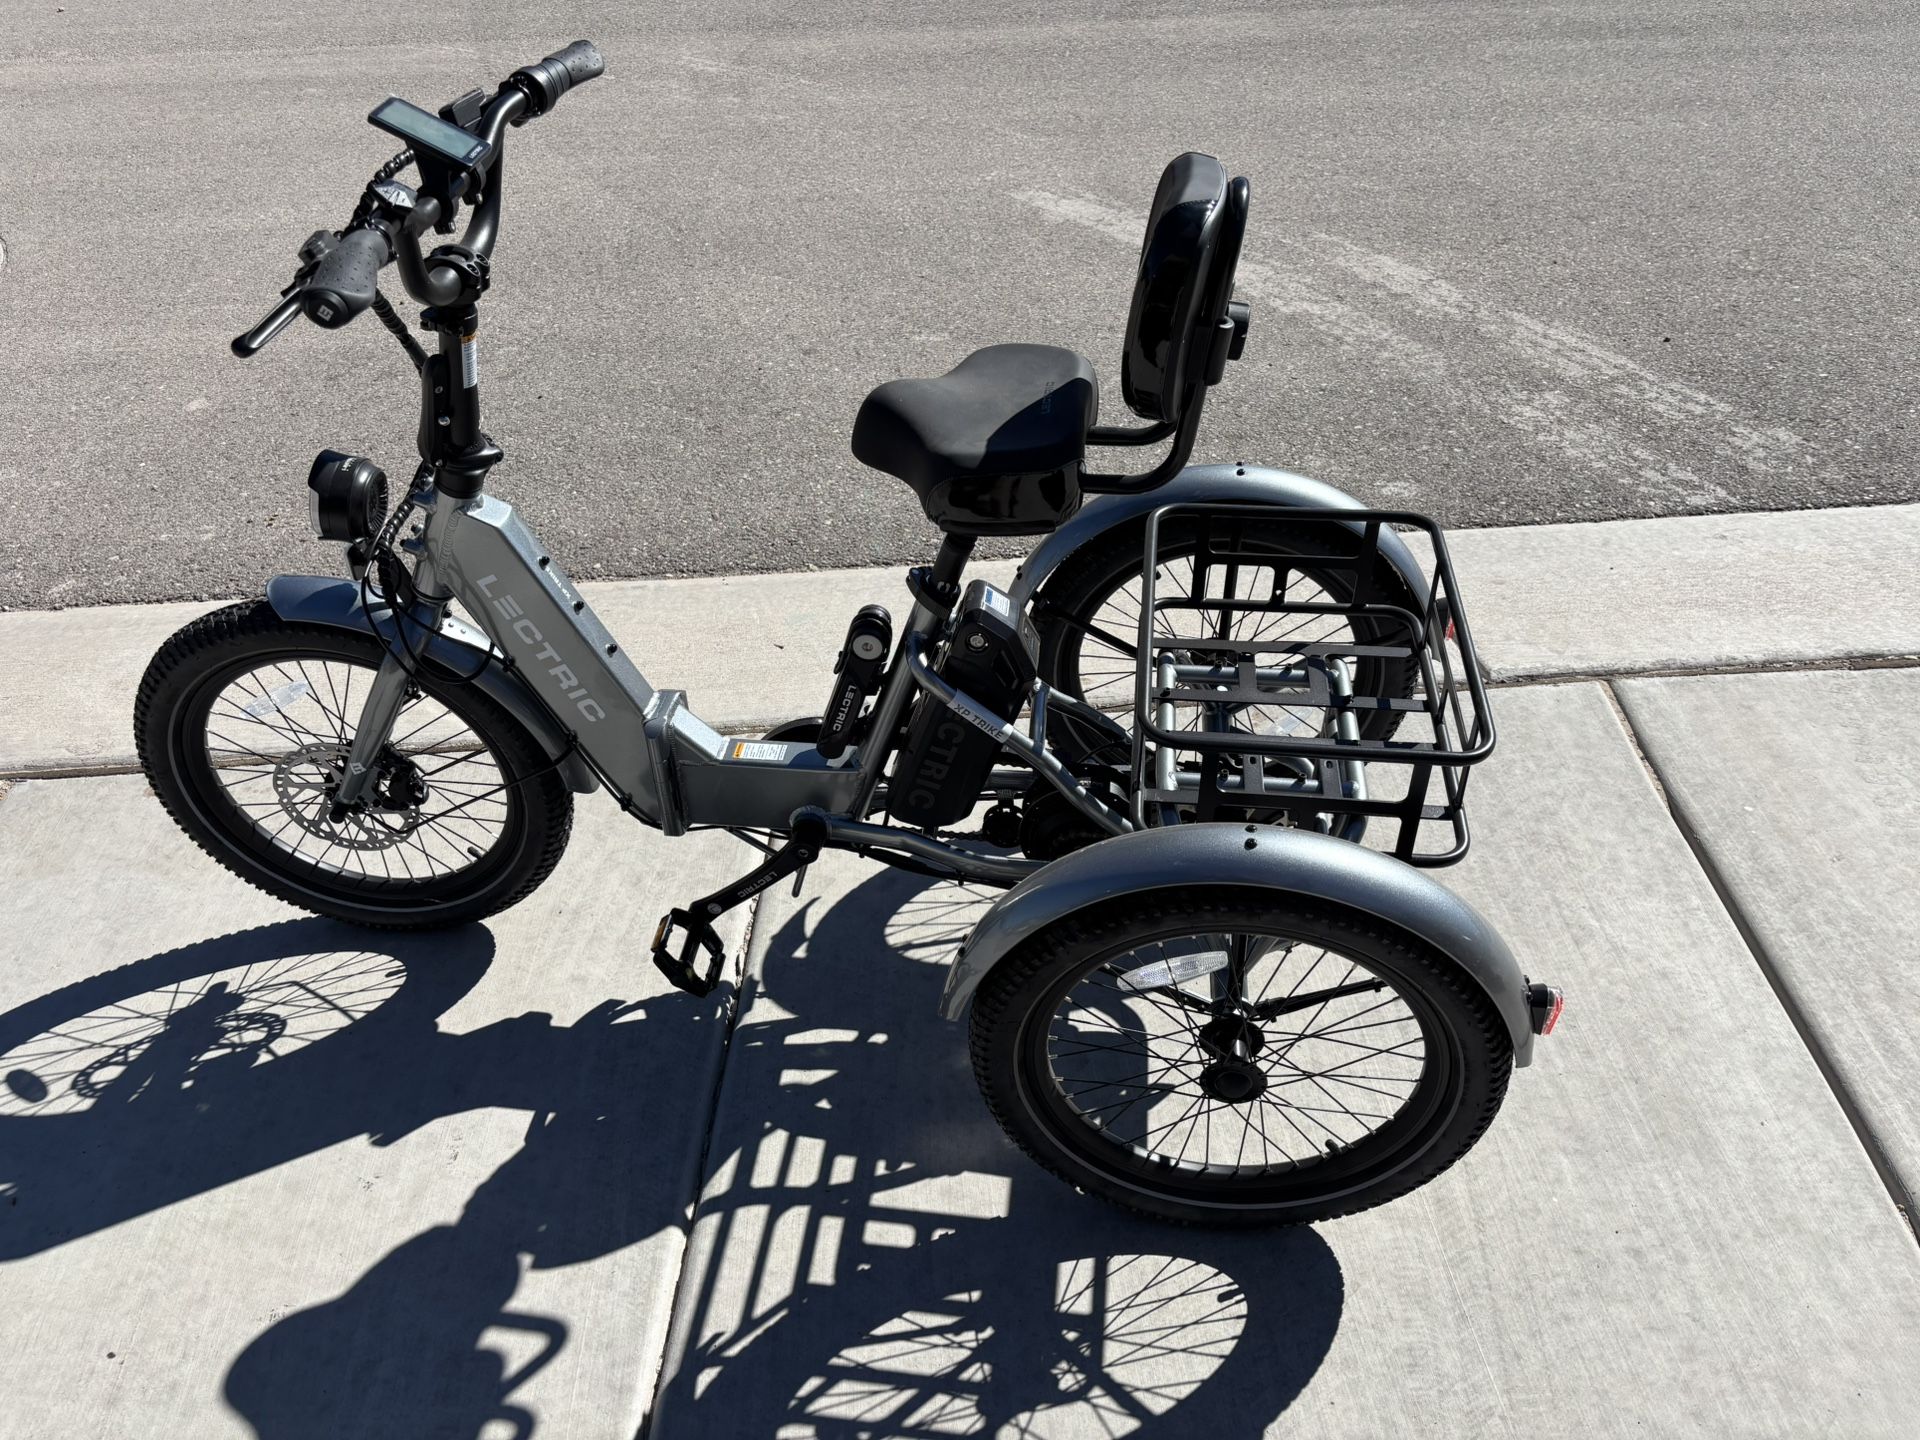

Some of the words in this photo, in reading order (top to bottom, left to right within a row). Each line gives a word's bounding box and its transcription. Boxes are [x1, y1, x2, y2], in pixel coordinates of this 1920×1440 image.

[476, 574, 606, 723] LECTRIC
[833, 684, 857, 731] LECTRIC
[953, 703, 971, 717] XP
[971, 714, 1005, 740] TRIKE
[908, 711, 966, 809] CTRIC
[737, 871, 778, 898] LECTRIC
